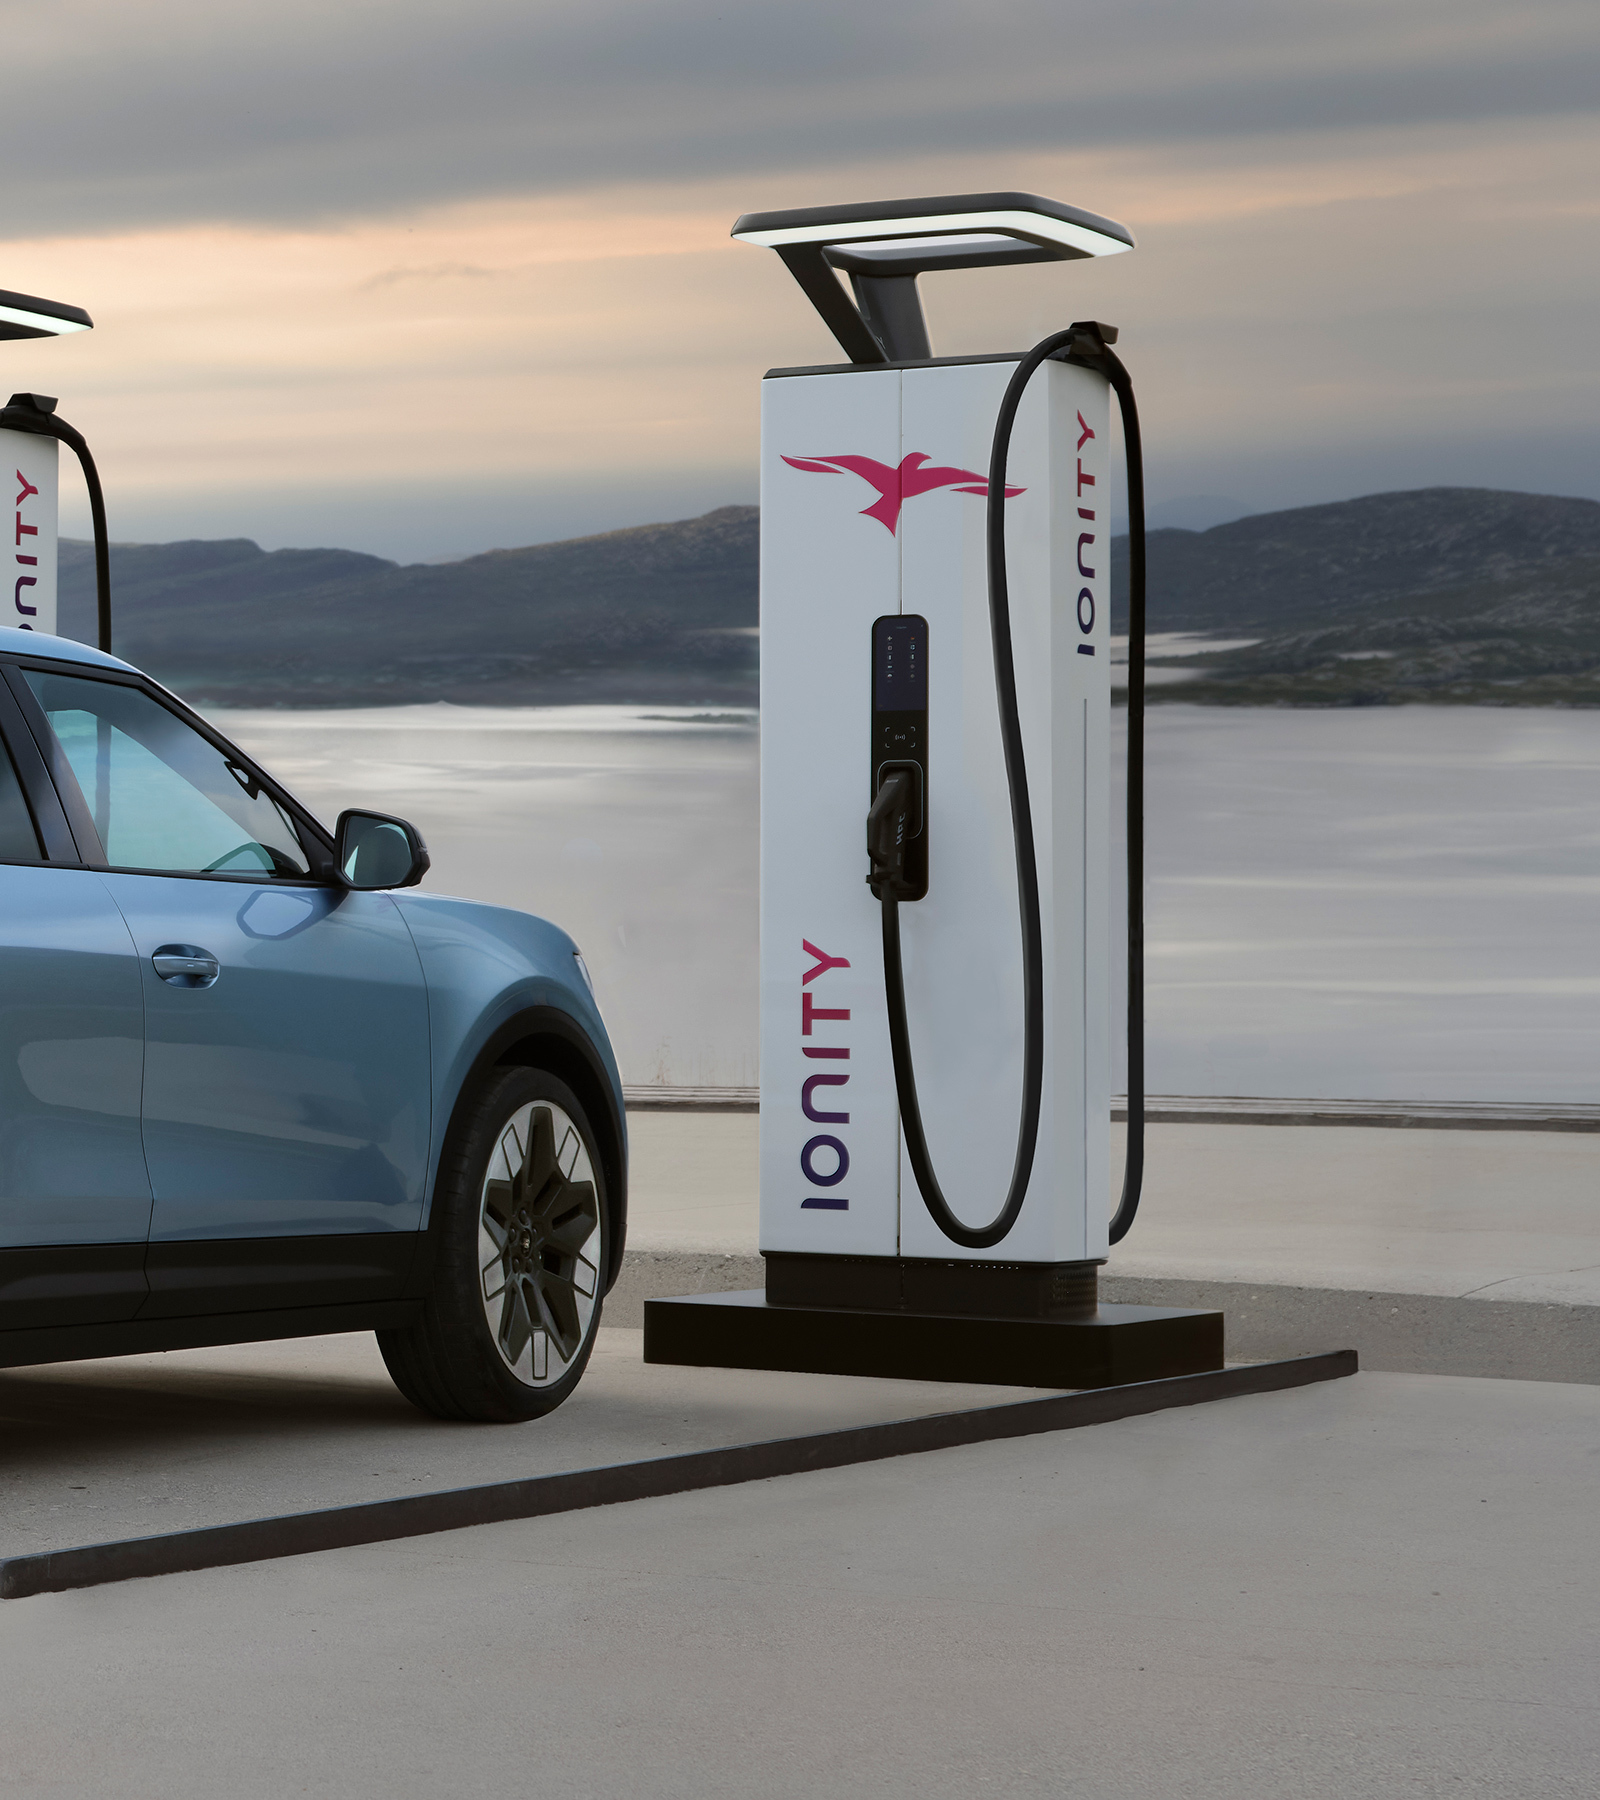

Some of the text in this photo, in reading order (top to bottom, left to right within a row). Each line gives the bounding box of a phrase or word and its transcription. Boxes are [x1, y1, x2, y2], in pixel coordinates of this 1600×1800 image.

[15, 468, 39, 631] NITY
[1077, 409, 1096, 657] IONITY
[800, 938, 852, 1211] IONITY
